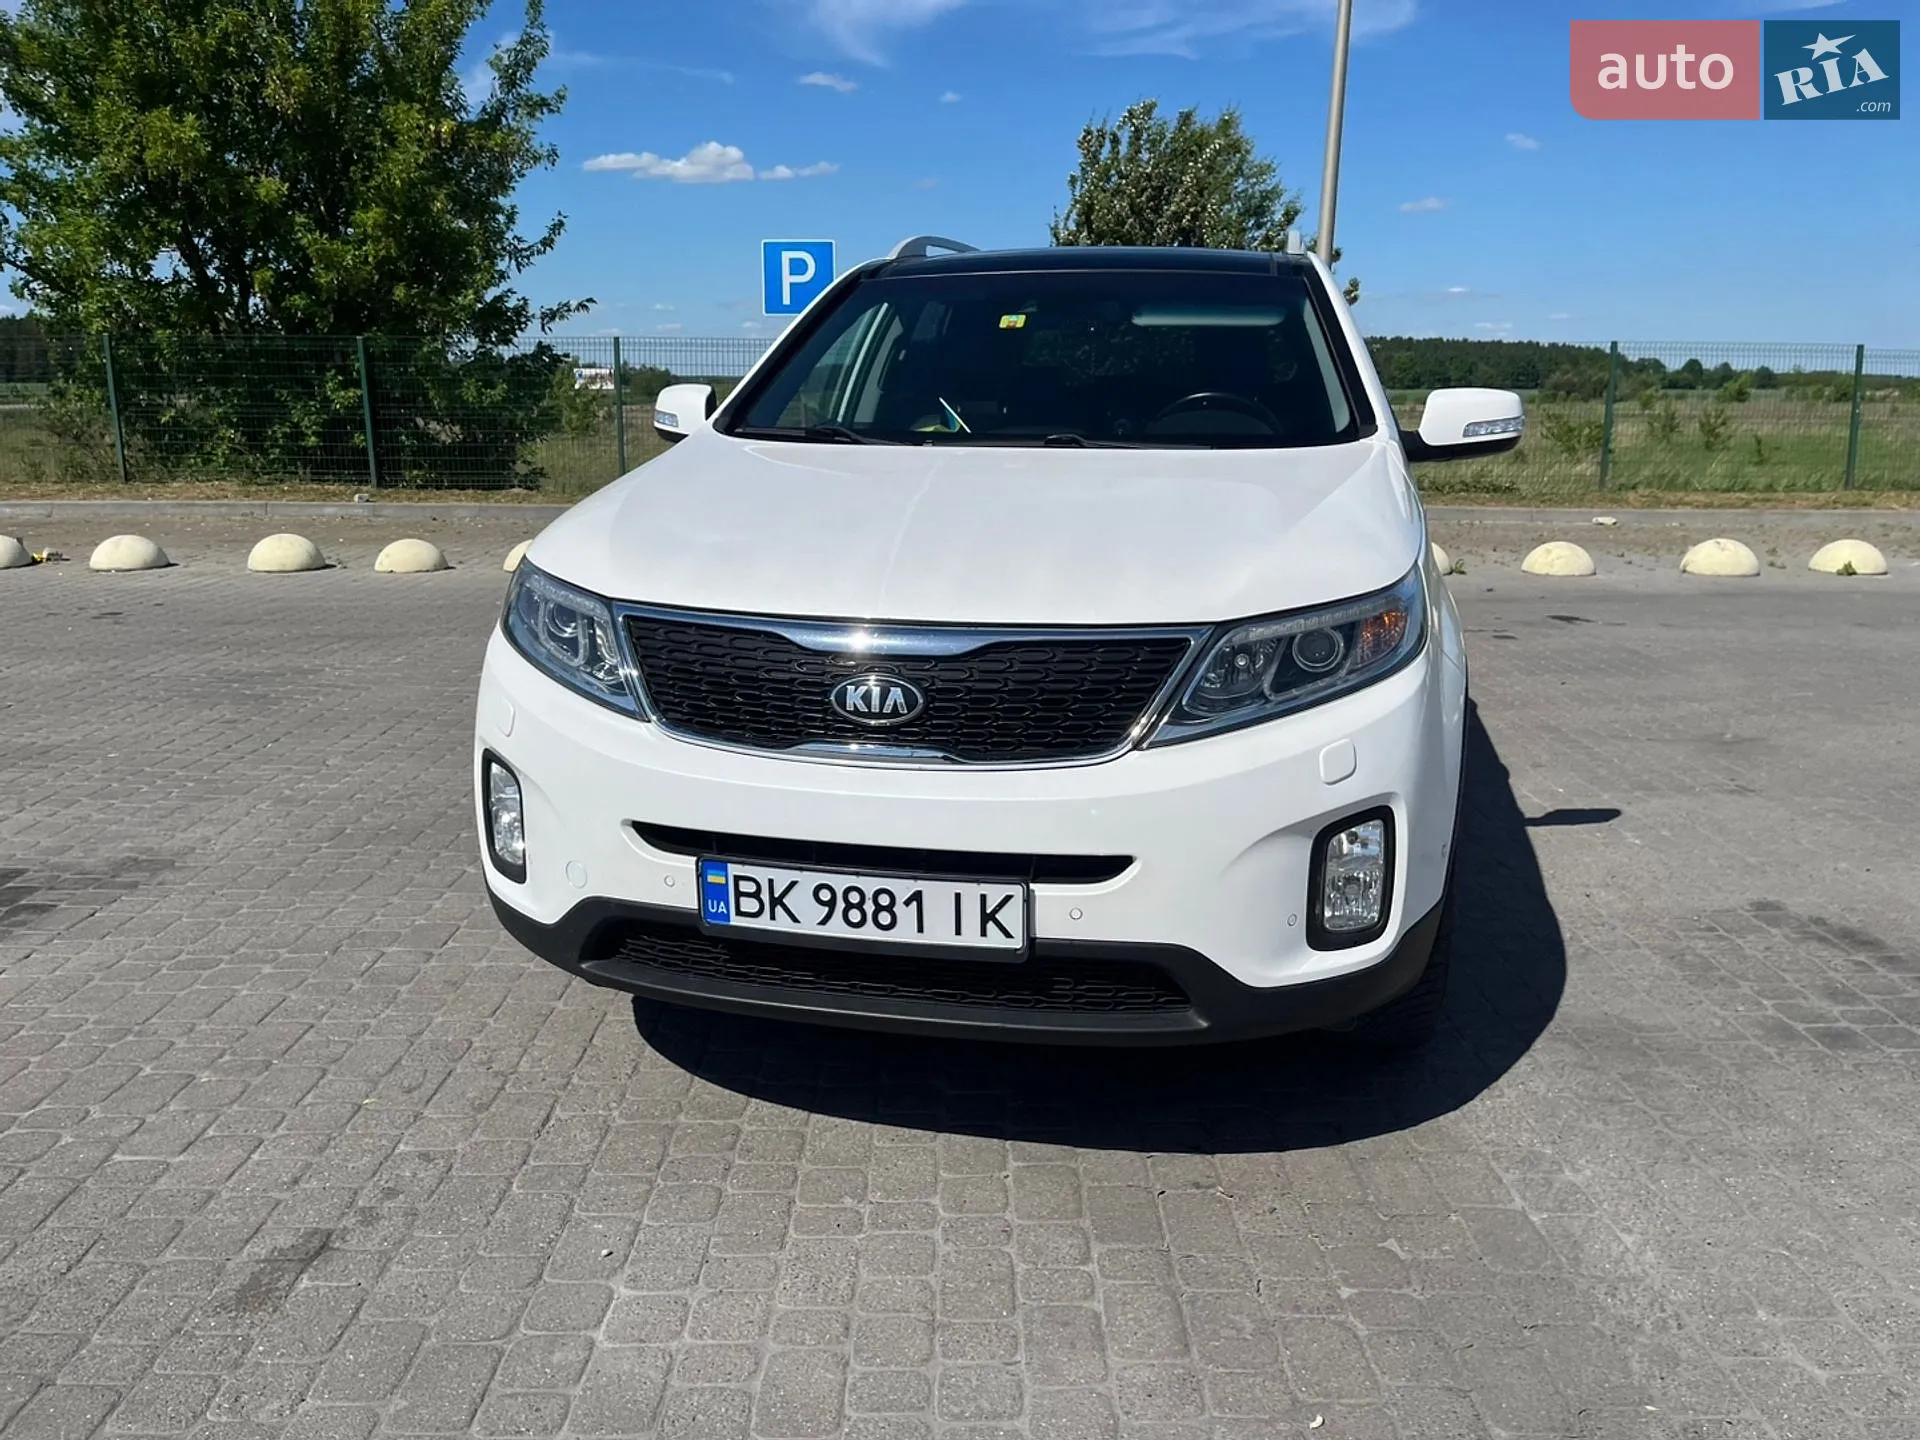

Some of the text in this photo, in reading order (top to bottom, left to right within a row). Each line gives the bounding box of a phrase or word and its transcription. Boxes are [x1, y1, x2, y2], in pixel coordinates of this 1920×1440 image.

[781, 250, 816, 305] P
[845, 685, 908, 714] KIA
[708, 899, 727, 914] UA
[733, 874, 1015, 939] BK 9881 IK
